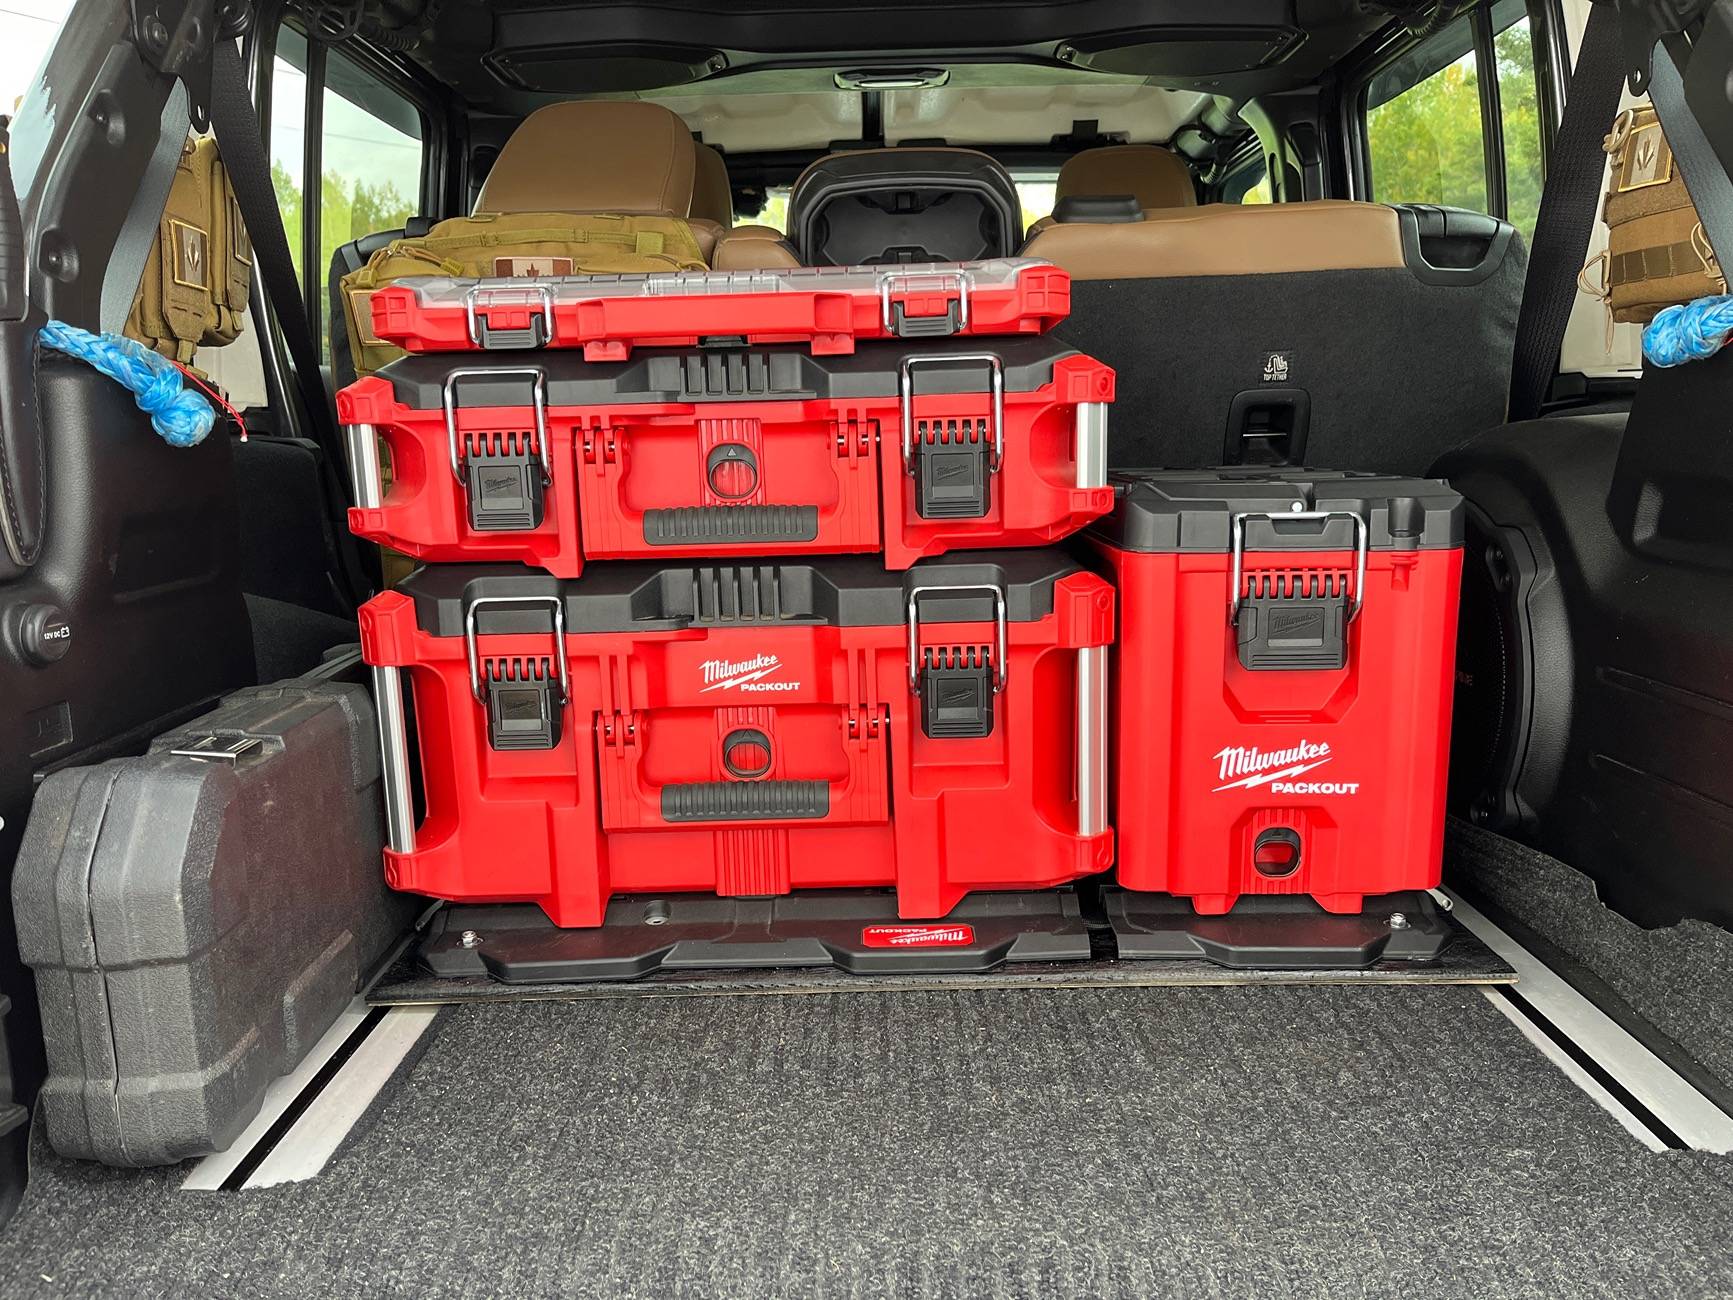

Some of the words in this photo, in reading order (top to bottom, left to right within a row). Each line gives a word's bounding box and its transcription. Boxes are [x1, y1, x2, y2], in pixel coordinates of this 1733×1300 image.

[44, 632, 54, 640] 12V
[53, 630, 61, 639] DC
[698, 653, 779, 685] Milwaukee
[740, 681, 800, 692] PACKOUT
[1212, 738, 1332, 781] Milwaukee
[1271, 782, 1360, 795] PACKOUT
[888, 930, 969, 945] Milwaukee
